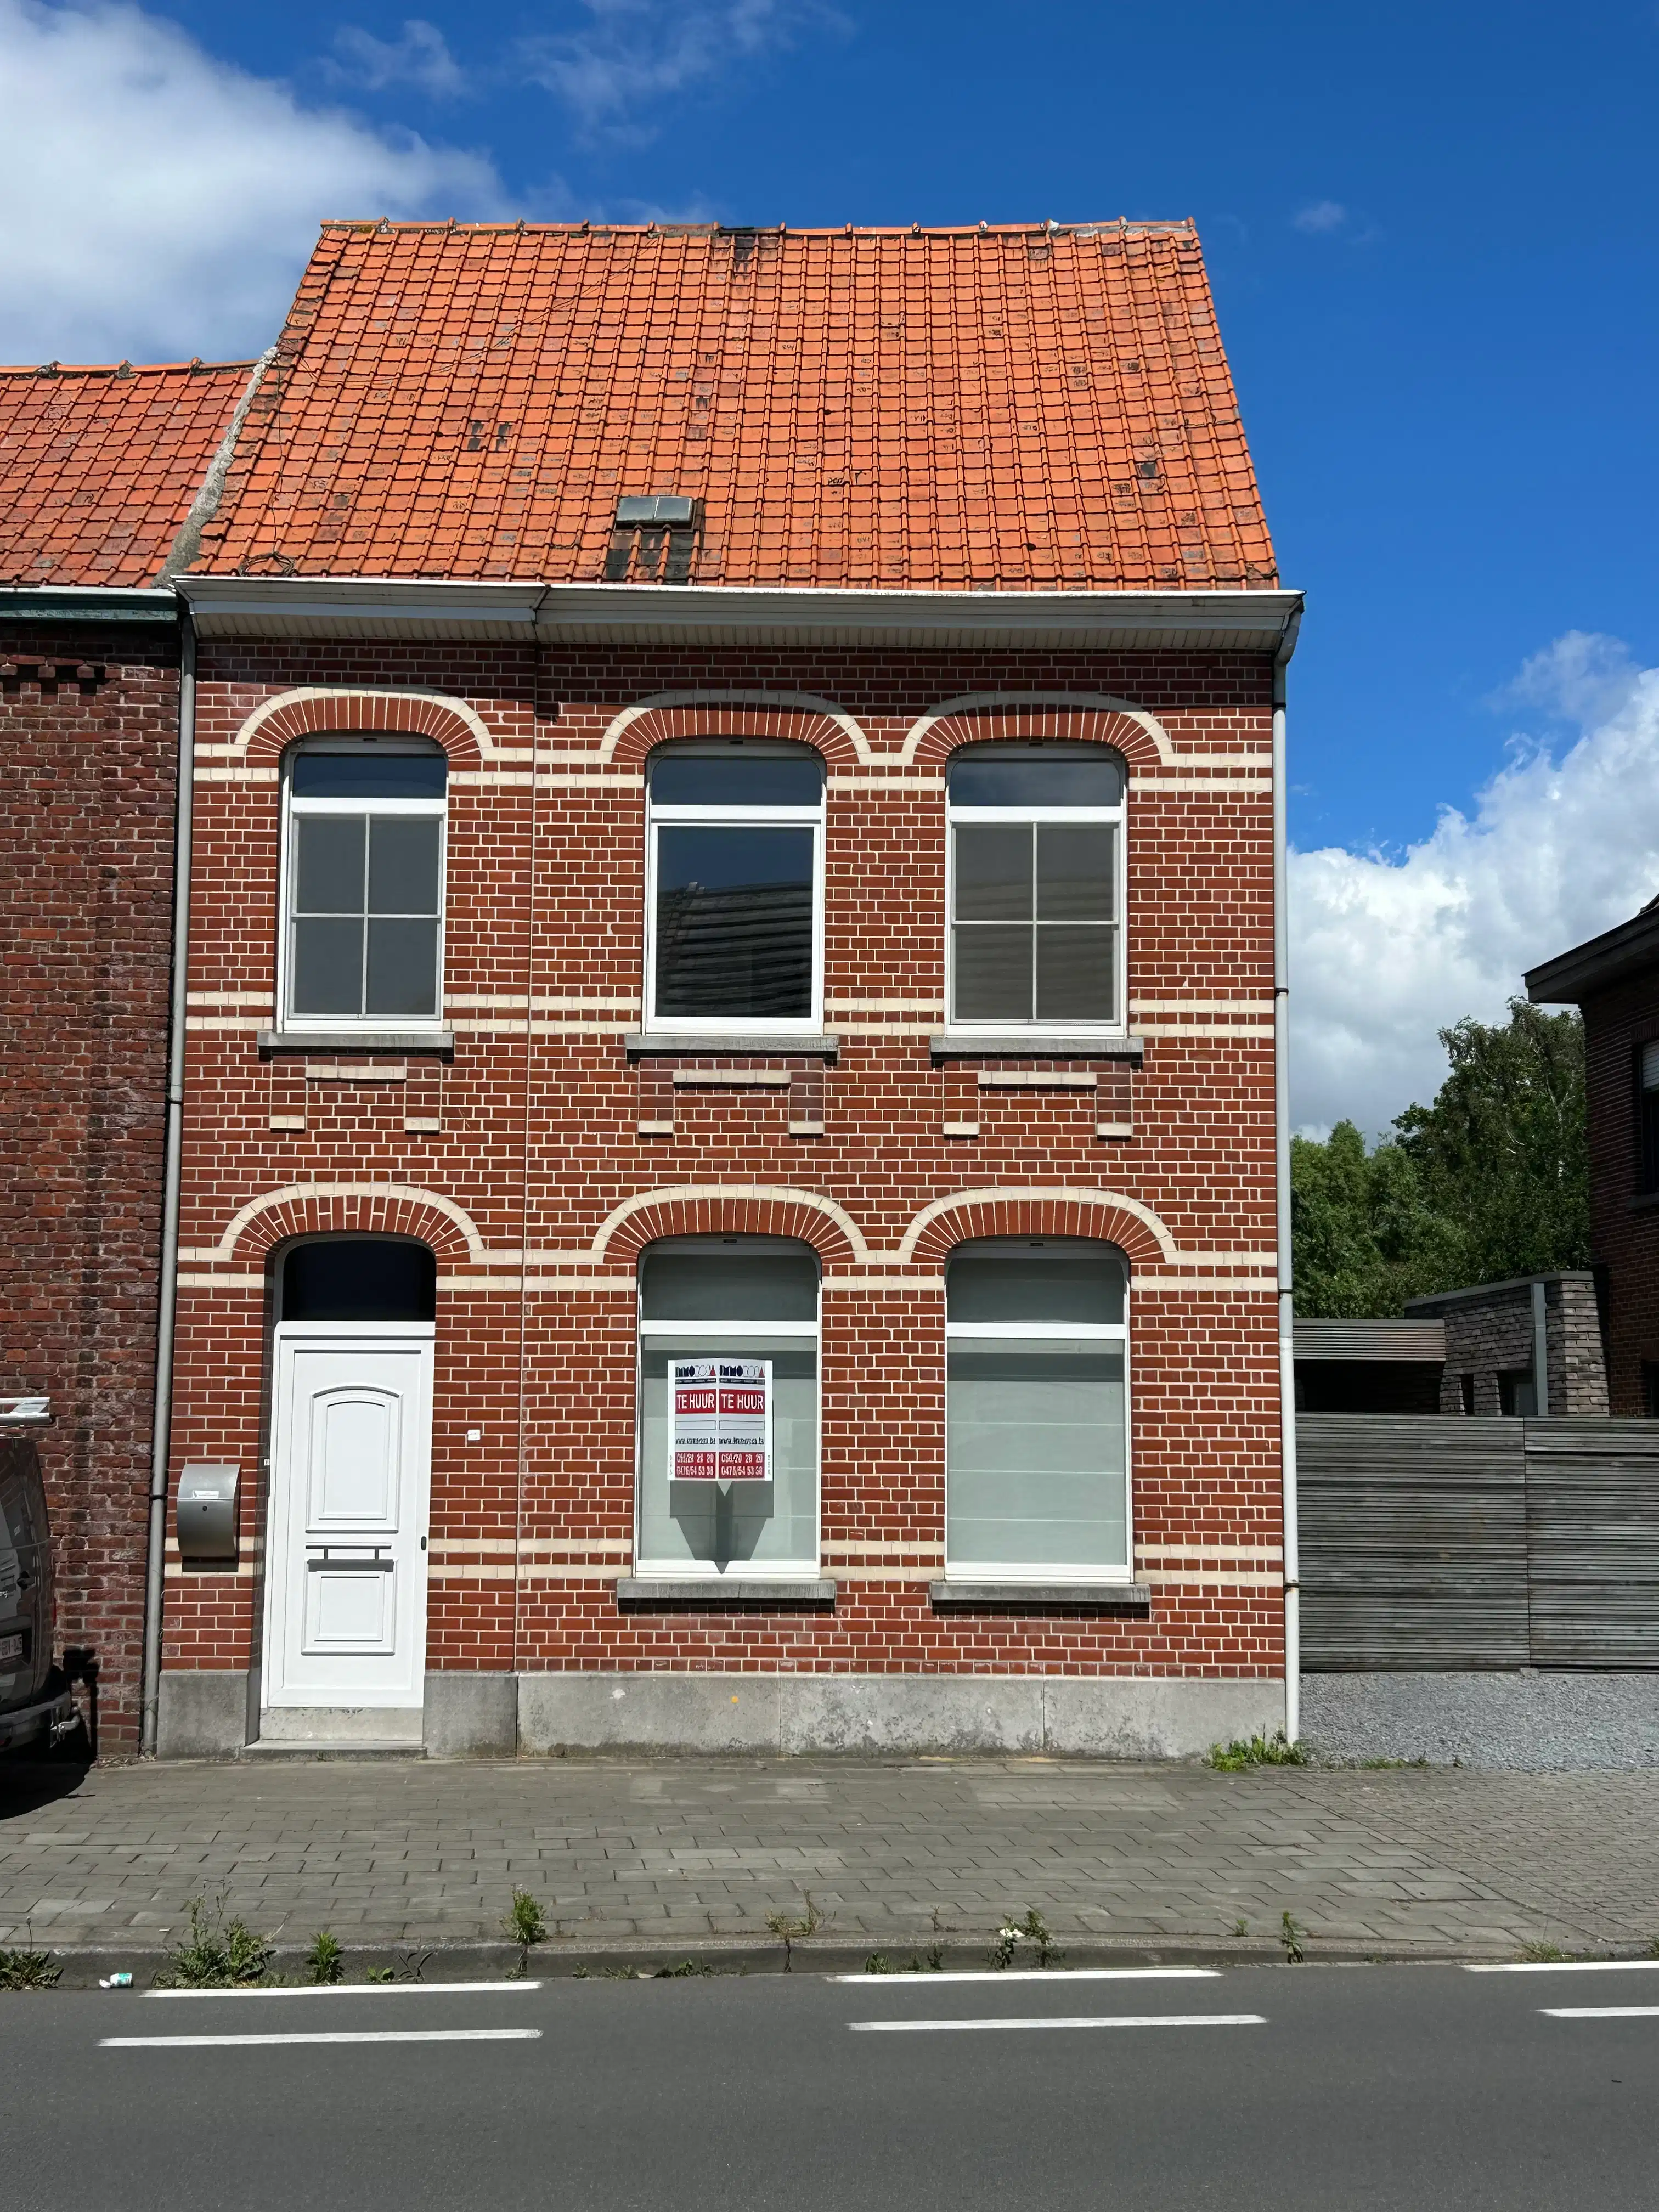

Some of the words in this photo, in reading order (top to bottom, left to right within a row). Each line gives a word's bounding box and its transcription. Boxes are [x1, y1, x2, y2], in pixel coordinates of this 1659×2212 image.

[676, 1394, 687, 1409] TE
[689, 1393, 714, 1409] HUUR
[721, 1393, 734, 1408] TE
[737, 1394, 764, 1409] HUUR
